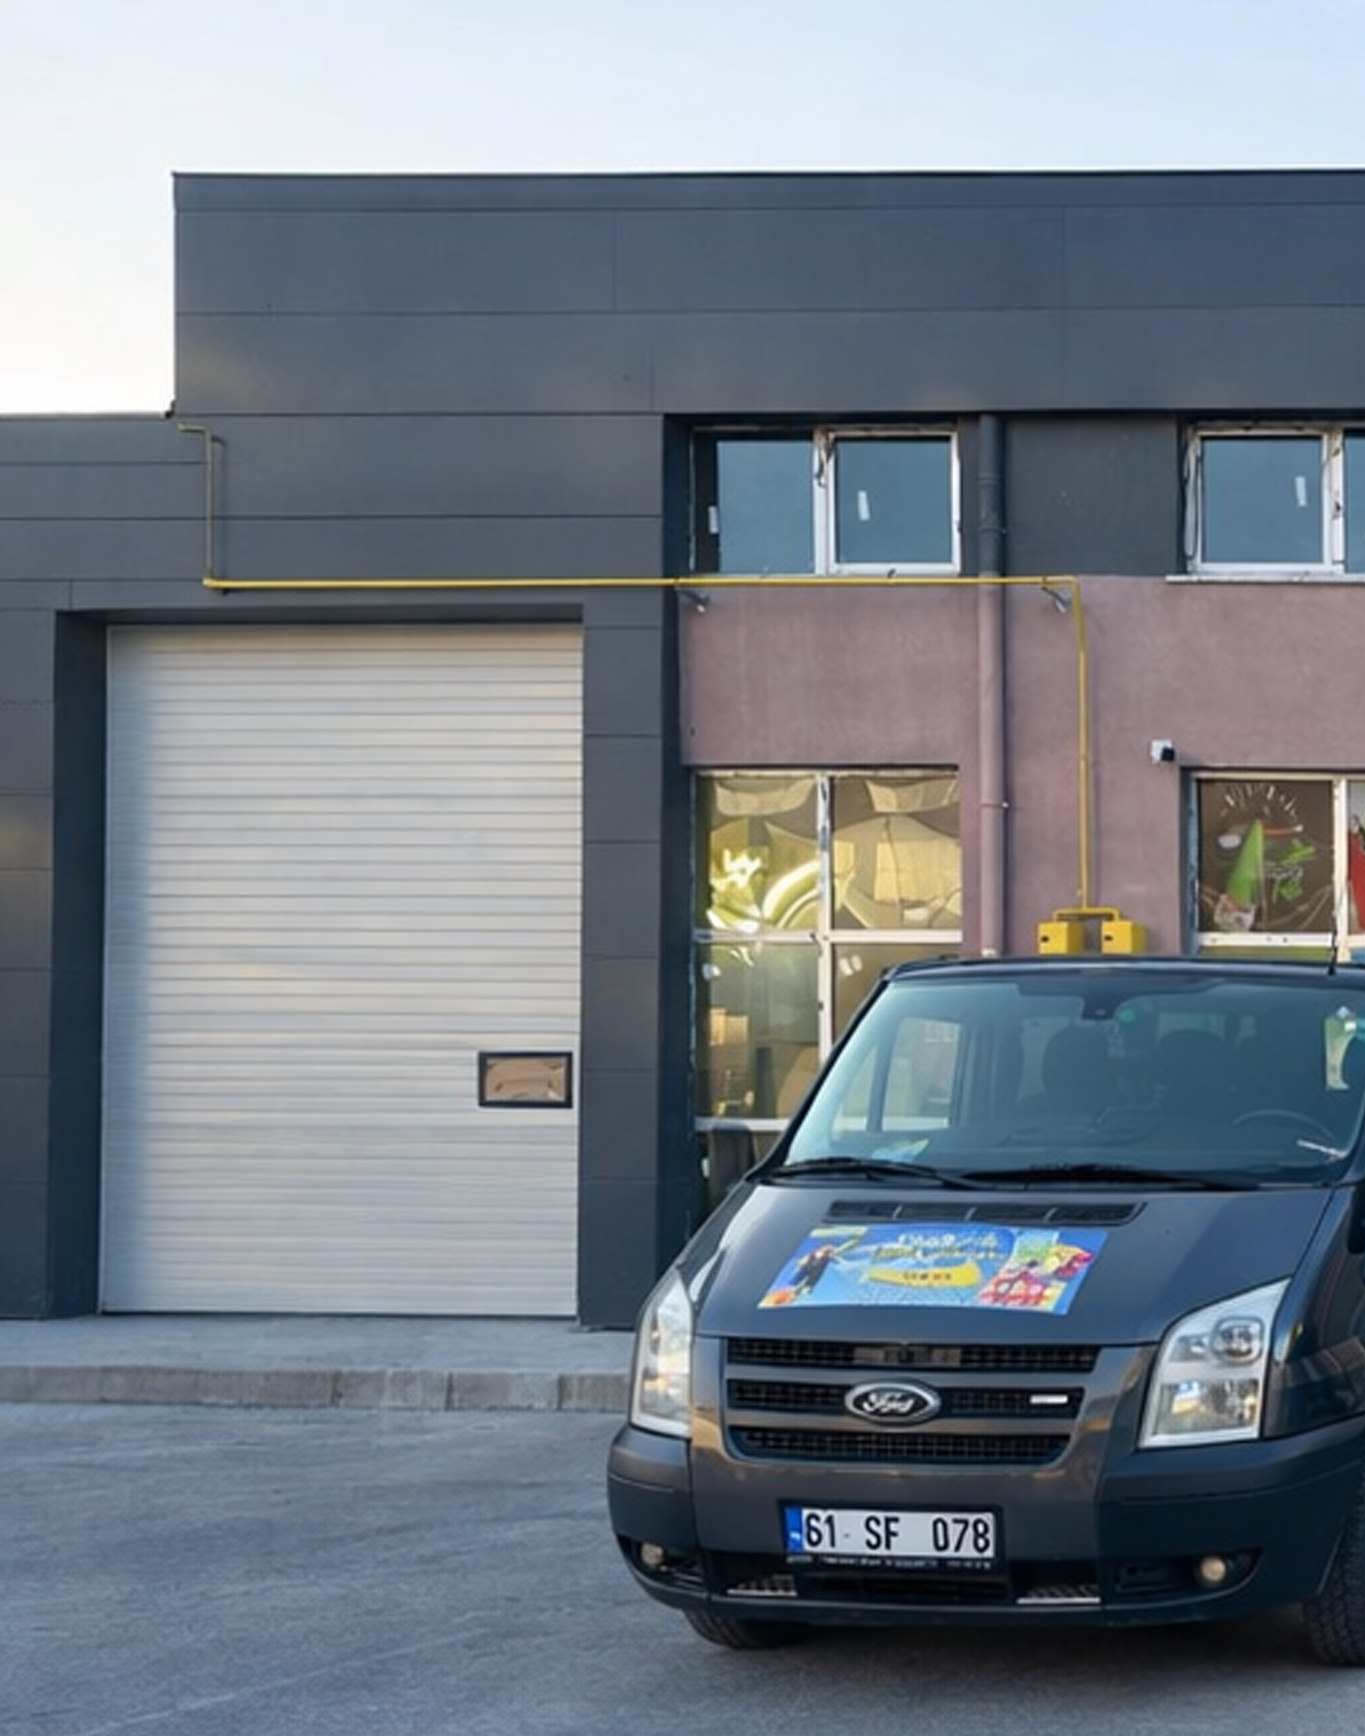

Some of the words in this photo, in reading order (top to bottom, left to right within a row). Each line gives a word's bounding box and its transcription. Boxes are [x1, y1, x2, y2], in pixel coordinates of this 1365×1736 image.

[805, 1512, 836, 1548] 61
[865, 1515, 900, 1550] SF
[932, 1517, 991, 1553] 078
